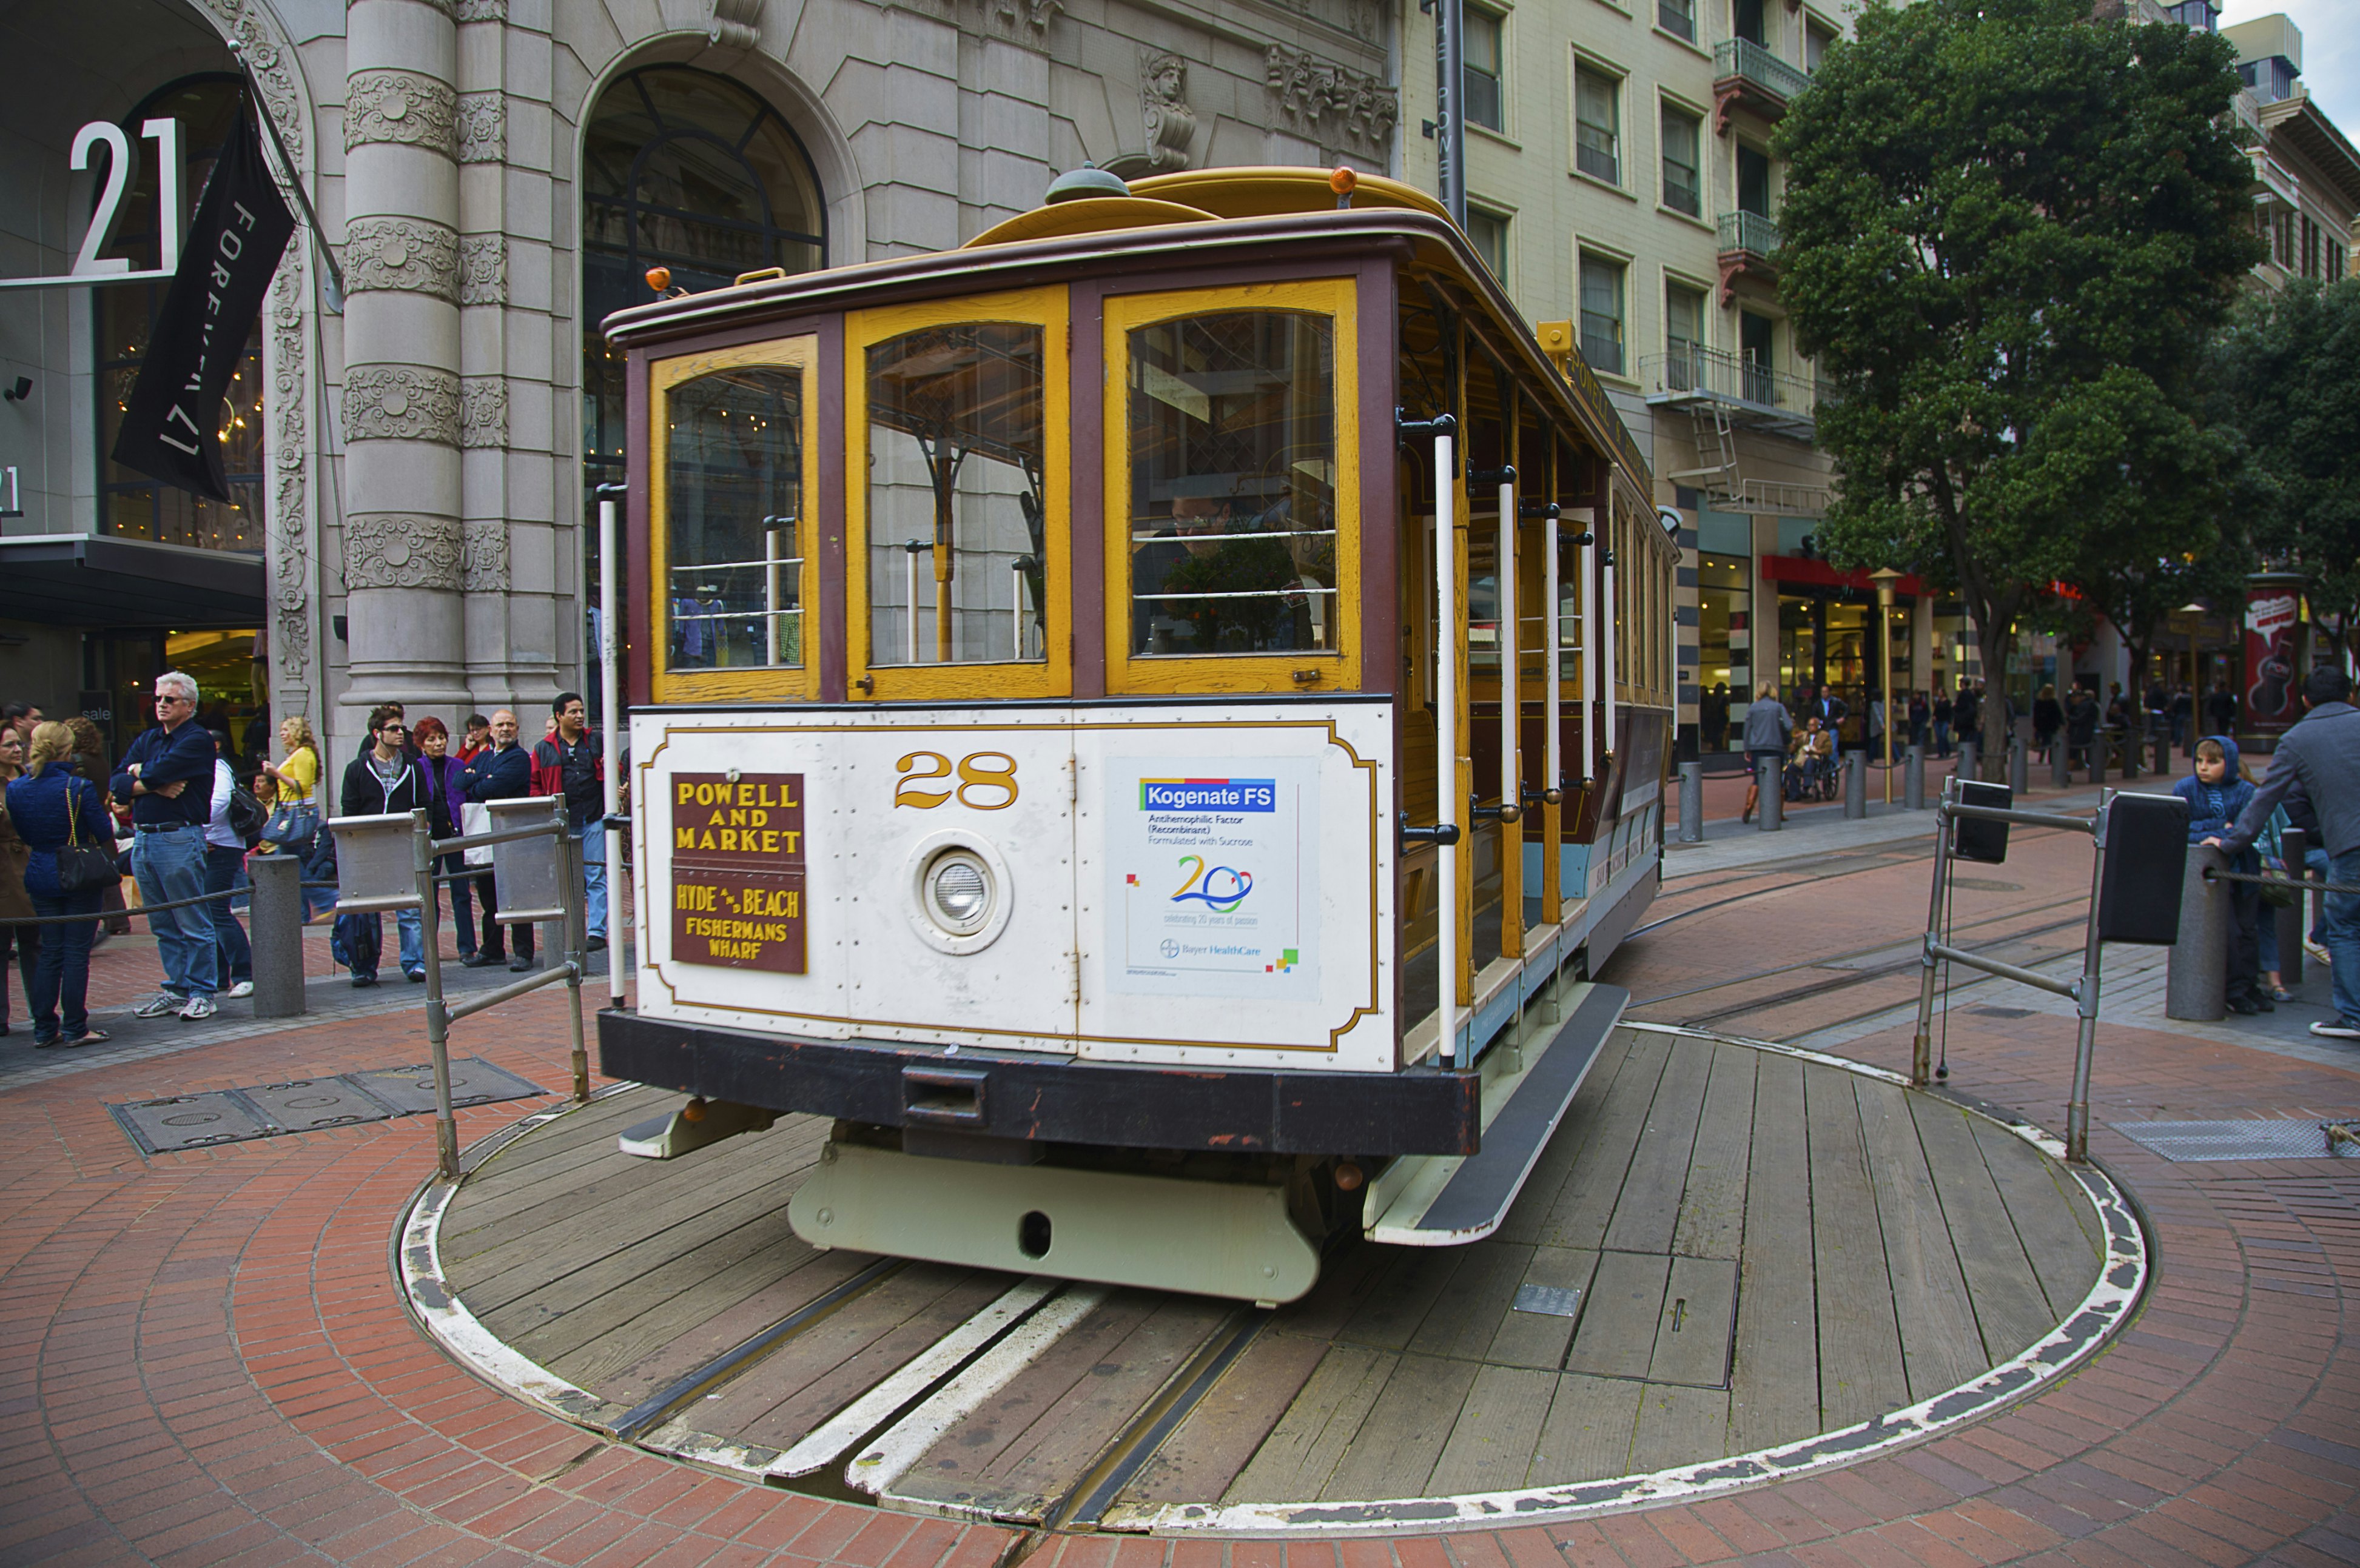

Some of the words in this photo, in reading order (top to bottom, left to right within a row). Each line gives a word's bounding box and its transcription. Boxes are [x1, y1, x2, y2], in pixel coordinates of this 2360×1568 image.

[70, 117, 178, 276] 21
[184, 200, 257, 392] FORE
[1571, 352, 1611, 429] POWELL
[1625, 435, 1641, 477] HYDE
[82, 707, 111, 721] sale
[895, 751, 1018, 811] 28
[677, 783, 799, 809] POWELL
[1148, 786, 1240, 809] Kogenate
[1245, 788, 1271, 806] FS
[707, 808, 768, 828] AND
[1148, 814, 1213, 825] Antihemophilic
[1215, 815, 1244, 825] Factor
[1148, 825, 1211, 835] (Recombinant)
[676, 826, 801, 854] MARKET
[1148, 836, 1197, 846] Formulated
[1198, 836, 1217, 846] with
[1219, 837, 1253, 846] Sucrose
[1170, 854, 1253, 914] 20
[676, 883, 718, 913] HYDE
[719, 886, 742, 914] AND
[742, 888, 799, 919] BEACH
[685, 917, 788, 943] FISHERMANS
[1163, 914, 1197, 925] celebrating
[1198, 914, 1207, 924] 20
[1209, 916, 1225, 925] years
[1226, 916, 1233, 925] of
[1234, 917, 1258, 926] passion
[708, 938, 762, 960] WHARF
[1182, 945, 1207, 956] Bayer
[1209, 945, 1261, 956] HealthCare
